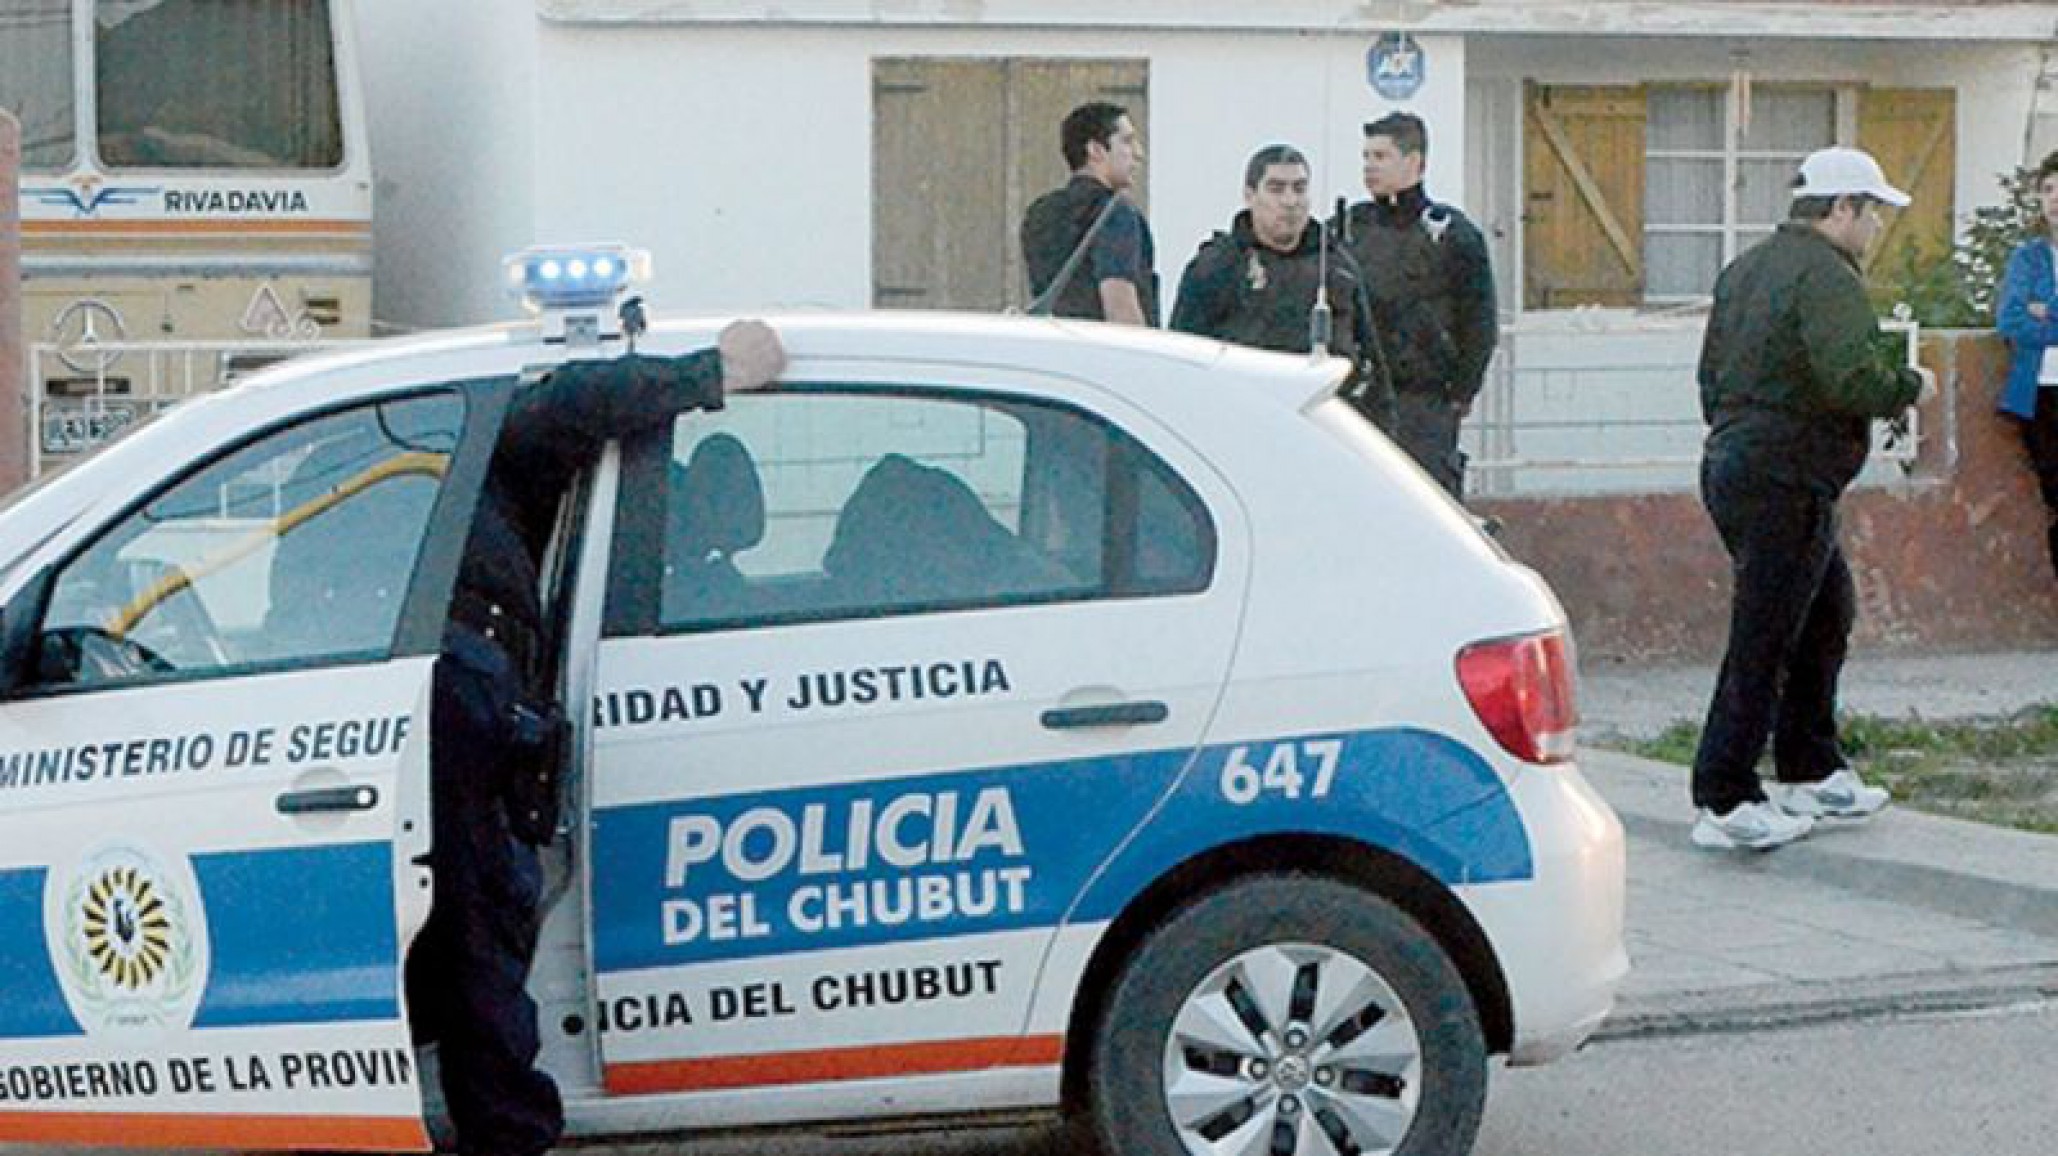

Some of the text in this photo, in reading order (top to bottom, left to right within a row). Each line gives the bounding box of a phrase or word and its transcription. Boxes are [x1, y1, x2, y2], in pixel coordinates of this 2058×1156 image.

[164, 190, 307, 212] RIVADAVIA
[740, 679, 766, 711] Y
[787, 659, 1010, 709] JUSTICIA
[0, 733, 213, 788] MINISTERIO
[225, 728, 276, 768] DE
[1220, 740, 1342, 803] 647
[665, 787, 1024, 888] POLICIA
[662, 866, 1031, 945] DEL CHUBUT
[710, 983, 795, 1021] DEL
[812, 960, 1002, 1010] CHUBUT
[168, 1057, 215, 1093] DE
[225, 1055, 271, 1090] LA
